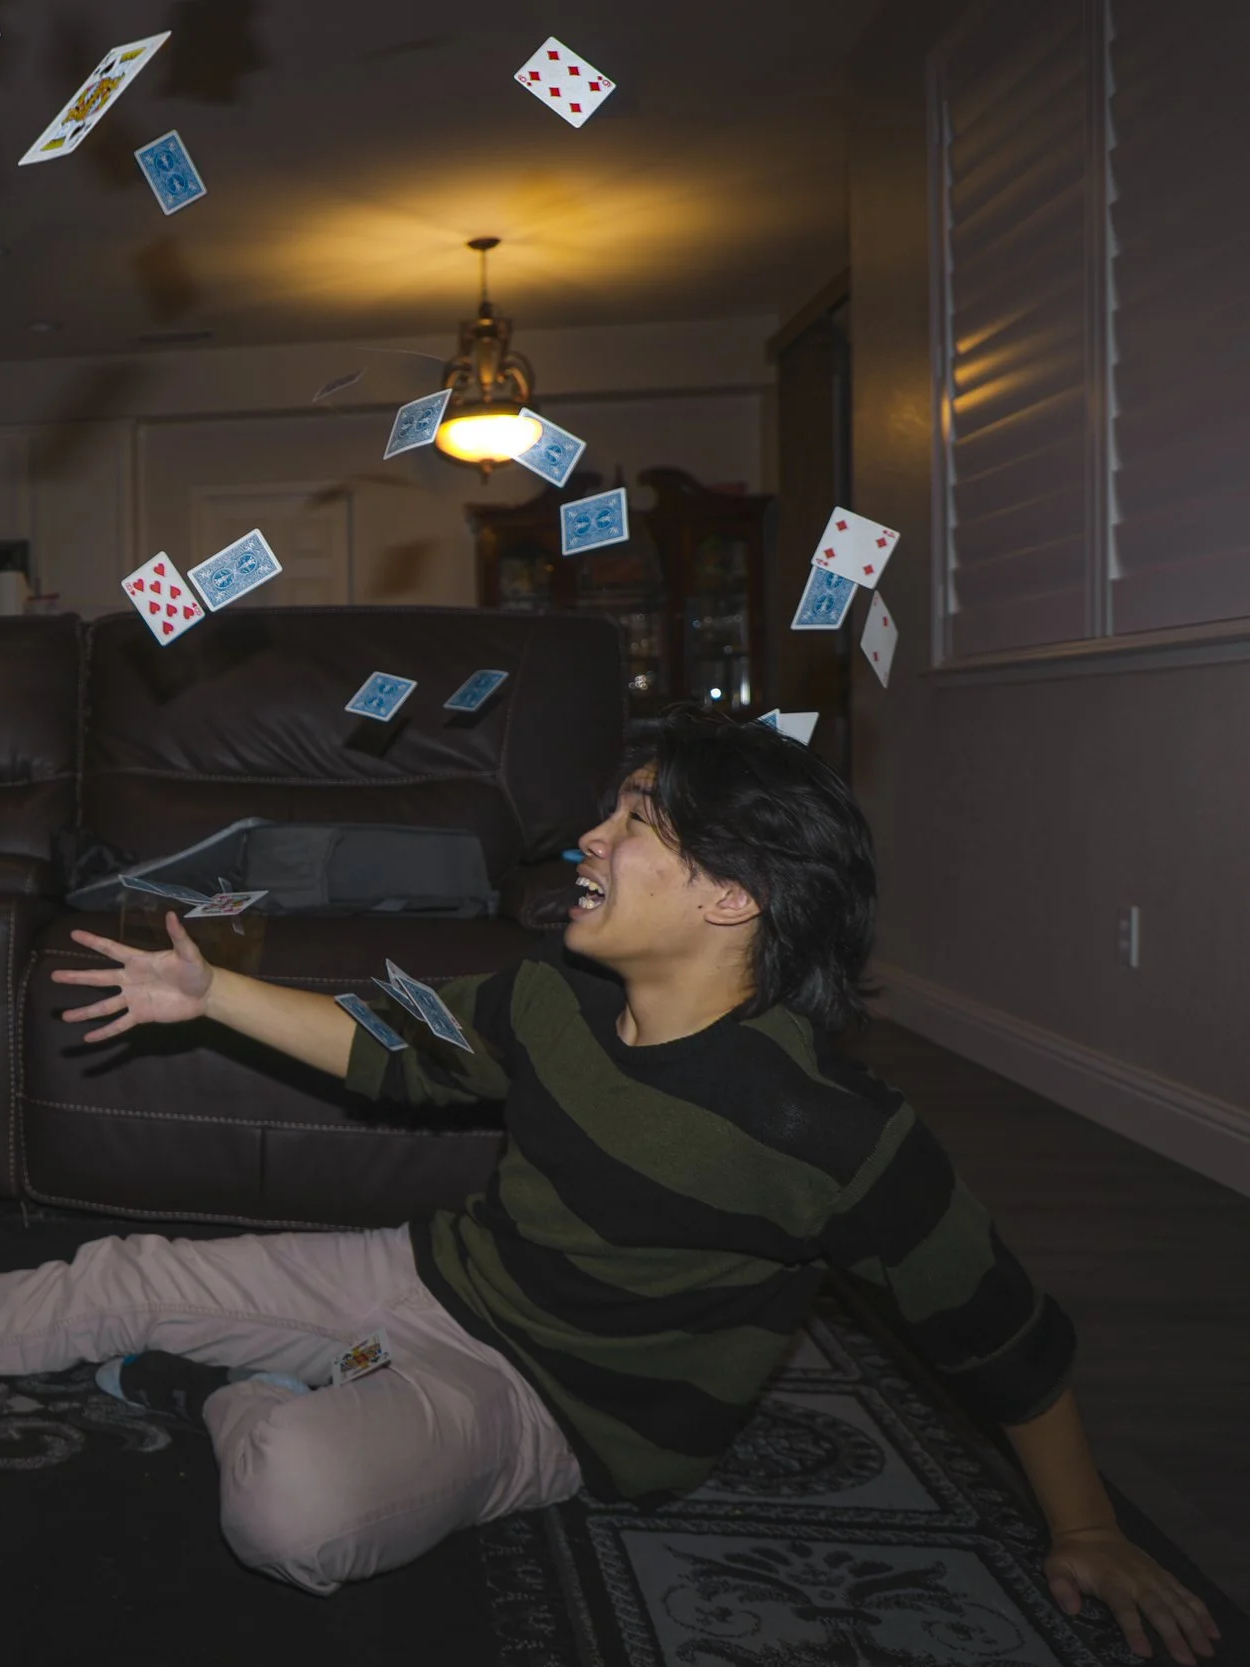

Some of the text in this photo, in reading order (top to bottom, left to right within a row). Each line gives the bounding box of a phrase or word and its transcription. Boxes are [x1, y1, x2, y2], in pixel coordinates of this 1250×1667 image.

[518, 74, 527, 83] 6
[602, 79, 611, 88] 6
[125, 582, 132, 591] 8
